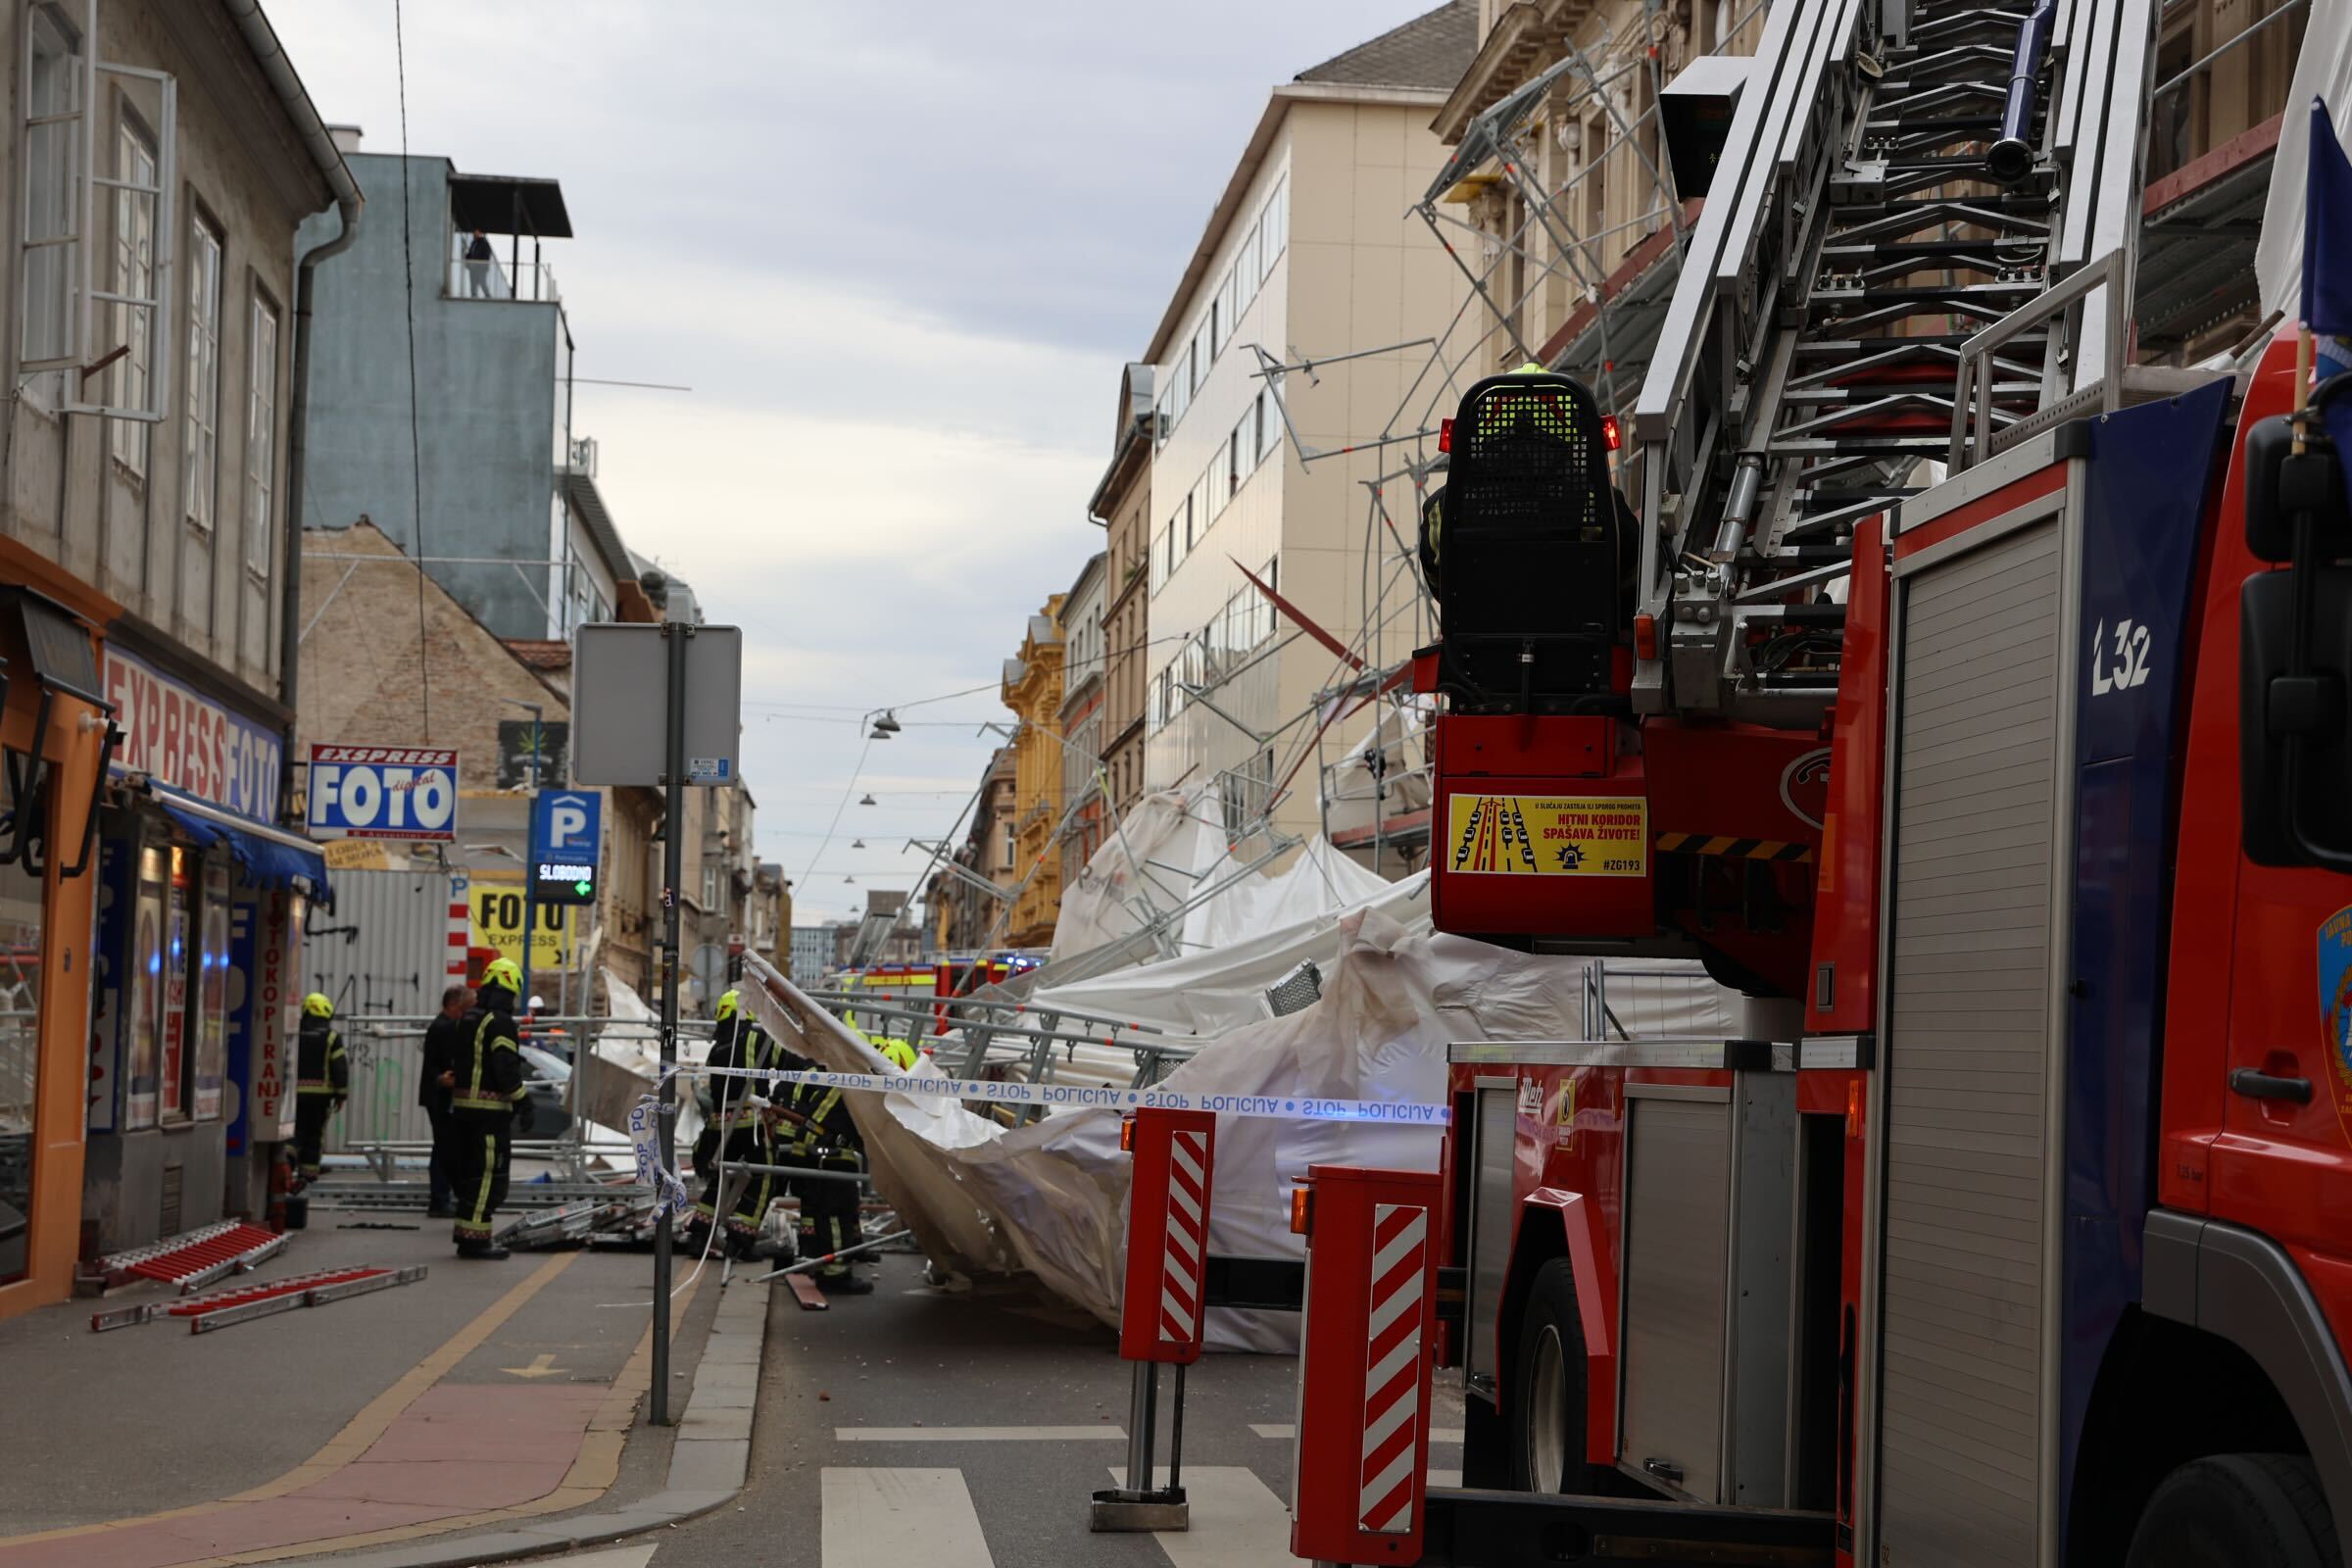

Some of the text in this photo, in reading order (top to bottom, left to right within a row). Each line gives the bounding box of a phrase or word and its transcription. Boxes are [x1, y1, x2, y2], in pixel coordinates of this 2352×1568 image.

[2092, 616, 2151, 697] L32
[108, 658, 280, 824] EXPRESS FOTO
[318, 747, 453, 764] EXSPRESS
[392, 770, 436, 794] digital
[311, 764, 454, 829] FOTO
[1557, 813, 1641, 825] HITNI KORIDOR
[1543, 825, 1641, 841] SPAŠAVA ŽIVOTE!
[539, 863, 592, 882] SLOBODNO
[1602, 859, 1641, 871] #ZG193
